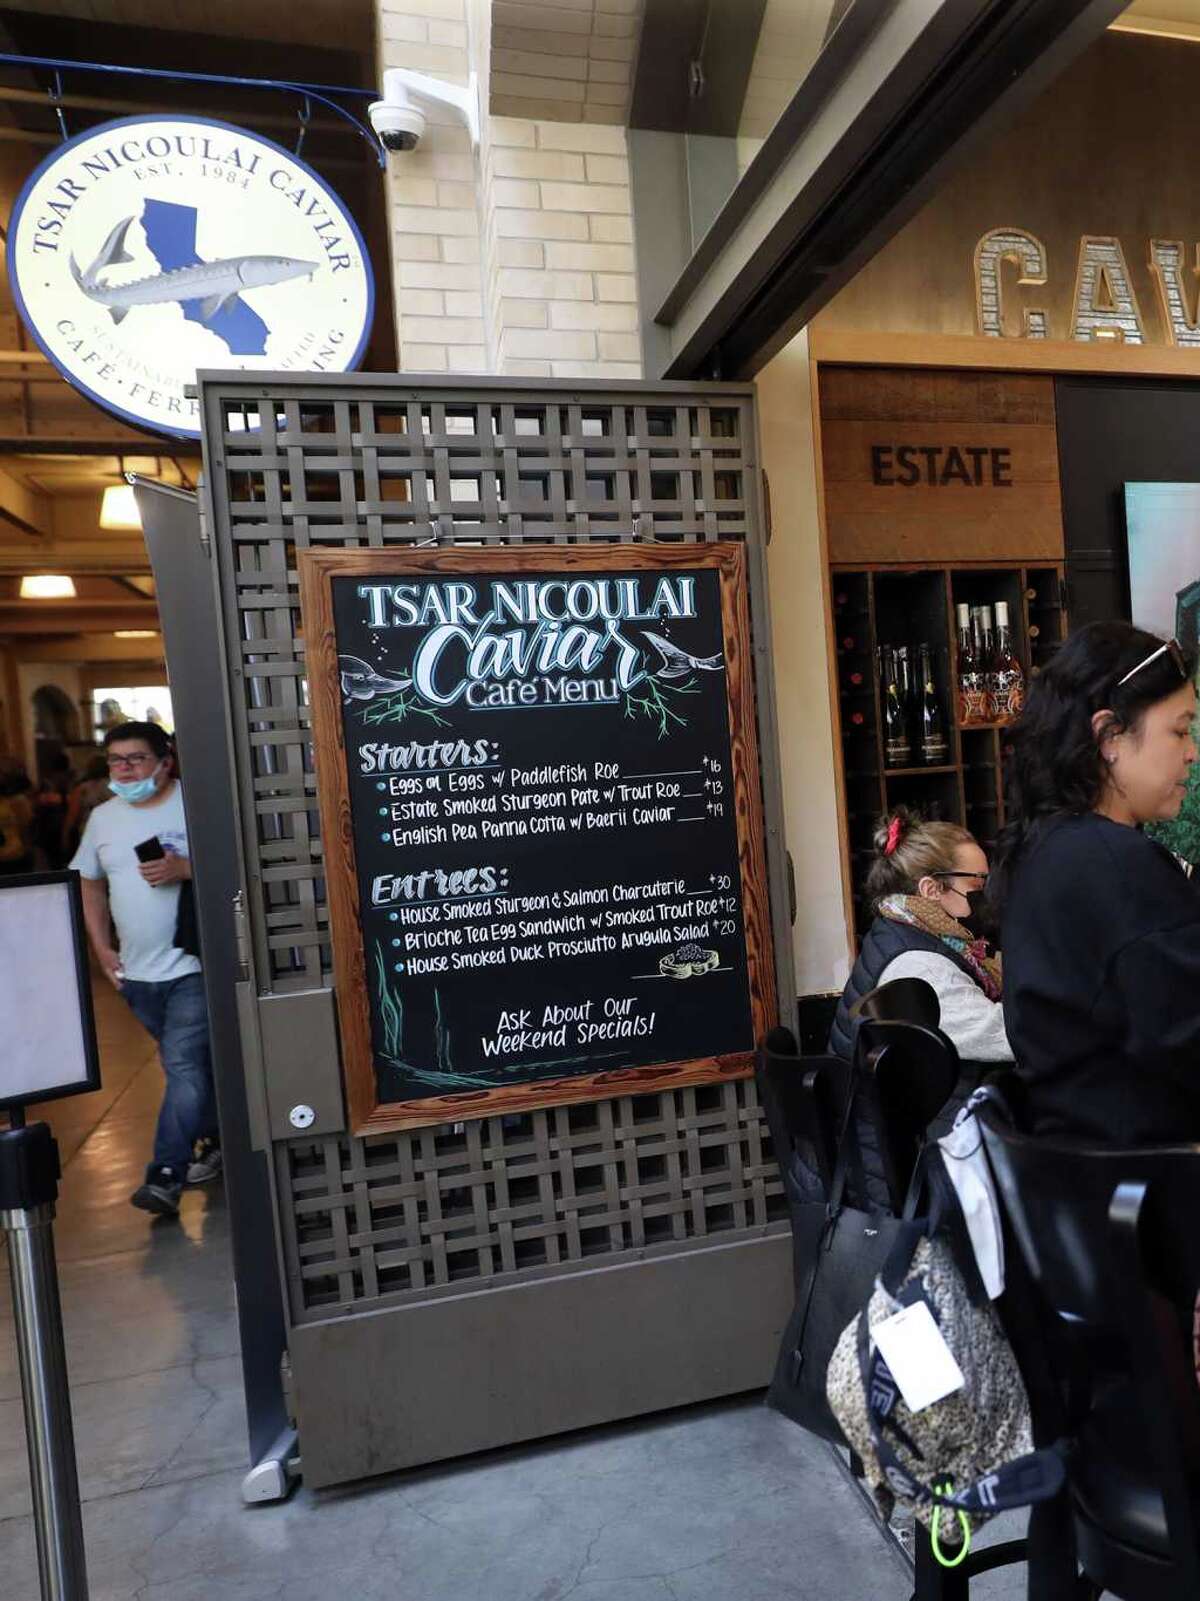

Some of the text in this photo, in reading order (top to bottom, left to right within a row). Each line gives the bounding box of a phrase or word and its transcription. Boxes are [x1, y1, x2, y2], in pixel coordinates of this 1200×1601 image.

[133, 163, 250, 189] EST. 1984
[33, 136, 351, 273] TSAR NICOULAI CAVIAR
[56, 319, 200, 416] CAFÉ FERR
[870, 445, 1013, 488] ESTATE
[358, 575, 698, 630] TSAR NICOULAI
[412, 611, 651, 706] Caviar
[466, 677, 620, 706] Café Menu
[358, 738, 500, 773] Starters:
[389, 777, 423, 796] Eggs
[425, 775, 442, 792] on
[448, 772, 485, 792] Eggs
[491, 769, 506, 788] w/
[511, 765, 587, 788] Paddlefish
[594, 762, 620, 780] Roe
[390, 802, 440, 822] Estate
[443, 795, 497, 817] Smoked
[501, 791, 567, 812] Sturgeon
[571, 787, 600, 807] Pate
[603, 787, 616, 804] w/
[617, 783, 653, 802] Trout
[655, 781, 681, 799] Roe
[392, 824, 447, 847] English
[452, 823, 478, 842] Pea
[481, 818, 528, 839] Panna
[529, 814, 566, 833] Cotta
[569, 813, 583, 831] w/
[586, 807, 627, 829] Baerii
[632, 805, 676, 826] Caviar
[371, 866, 510, 906] Entrees:
[401, 904, 441, 925] House
[443, 900, 492, 921] Smoked
[495, 894, 550, 916] Sturgeon
[551, 891, 562, 909] &
[563, 888, 609, 908] Salmon
[612, 879, 685, 902] Charcuterie
[404, 929, 462, 951] Brioche
[463, 925, 488, 944] Tea
[491, 923, 517, 941] Egg
[519, 914, 585, 938] Sandwich
[590, 913, 602, 928] w/
[605, 905, 655, 927] Smoked
[656, 901, 694, 920] Trout
[696, 899, 718, 917] Roe
[407, 956, 449, 976] House
[451, 947, 506, 970] Smoked
[511, 944, 544, 962] Duck
[547, 934, 616, 959] Prosciutto
[621, 927, 672, 950] Arugula
[673, 921, 710, 941] Salad
[481, 1012, 656, 1058] Weekend Specials!
[497, 997, 638, 1034] Ask About Our
